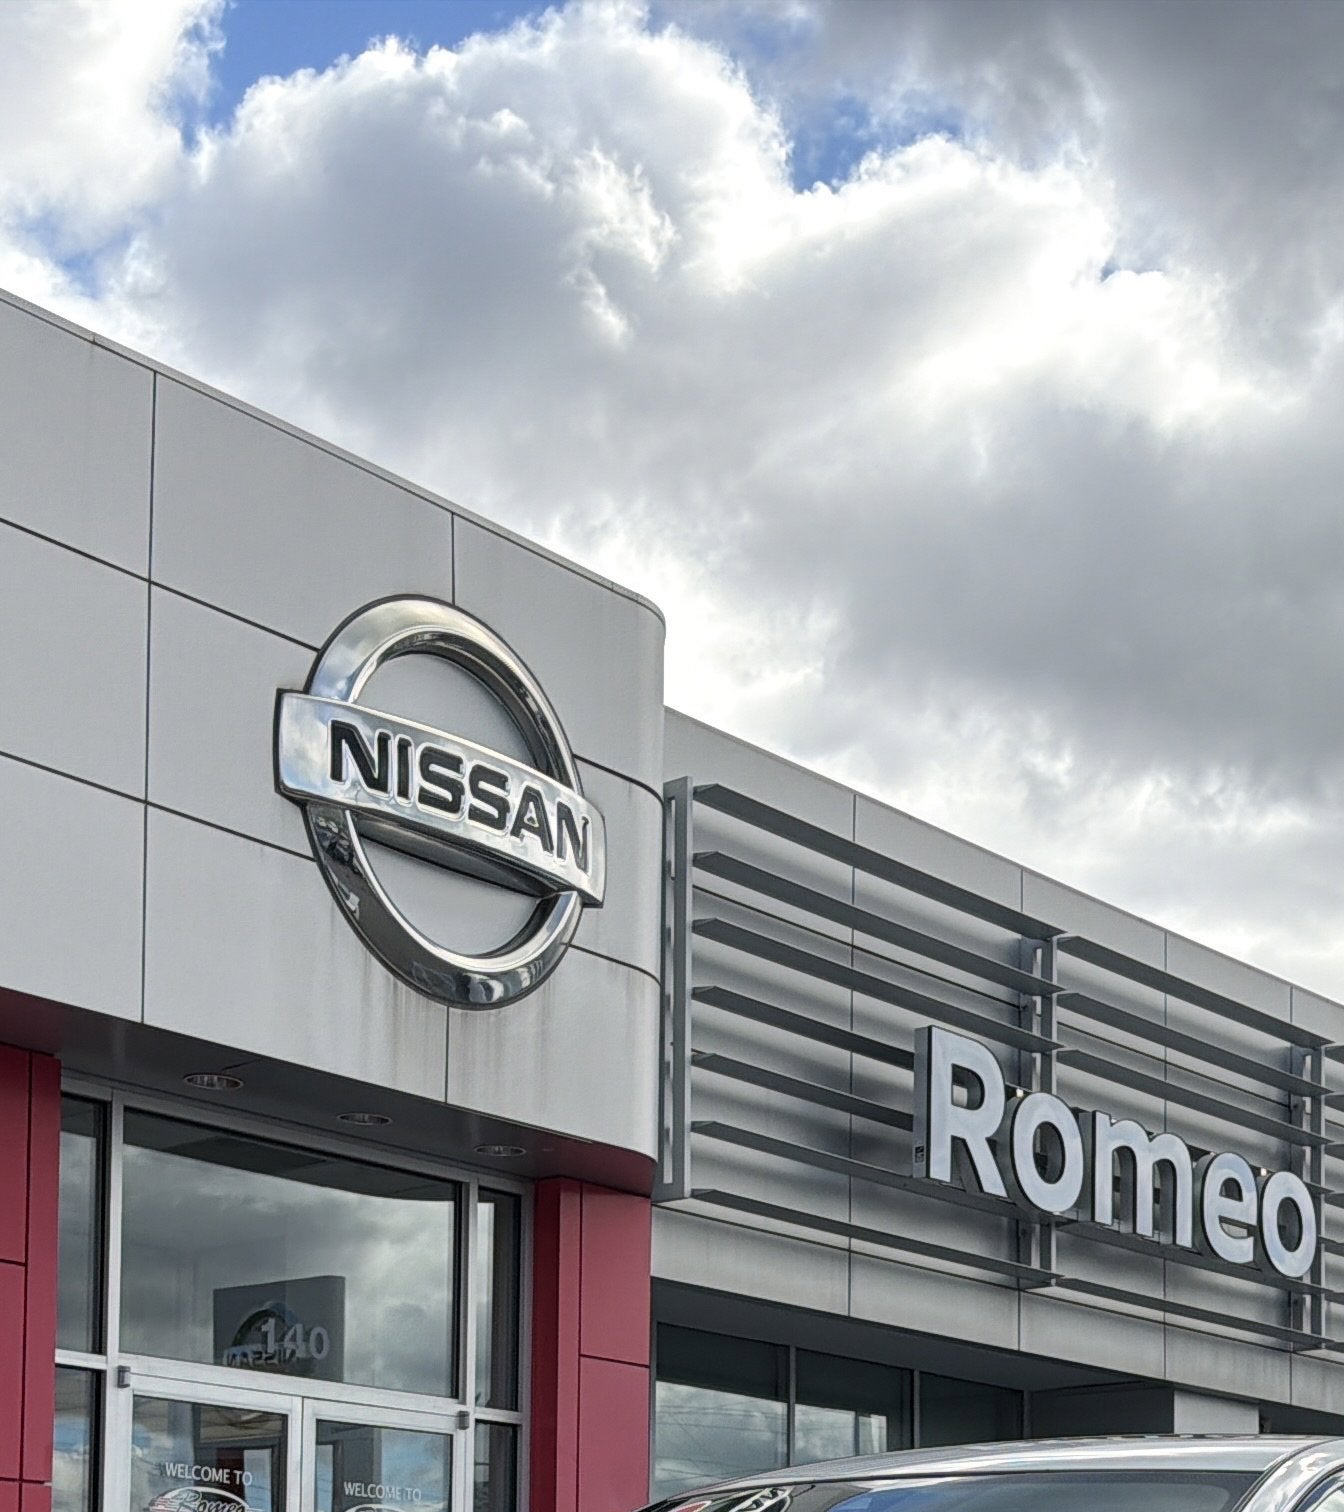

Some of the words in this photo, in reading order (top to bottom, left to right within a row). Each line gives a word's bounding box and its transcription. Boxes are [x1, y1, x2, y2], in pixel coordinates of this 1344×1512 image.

[328, 717, 590, 875] NISSAN
[916, 1025, 1317, 1278] Romeo
[261, 1317, 331, 1360] 140
[165, 1462, 231, 1484] WELCOME
[233, 1470, 253, 1486] TO
[343, 1481, 402, 1500] WELCOME
[405, 1487, 422, 1501] TO
